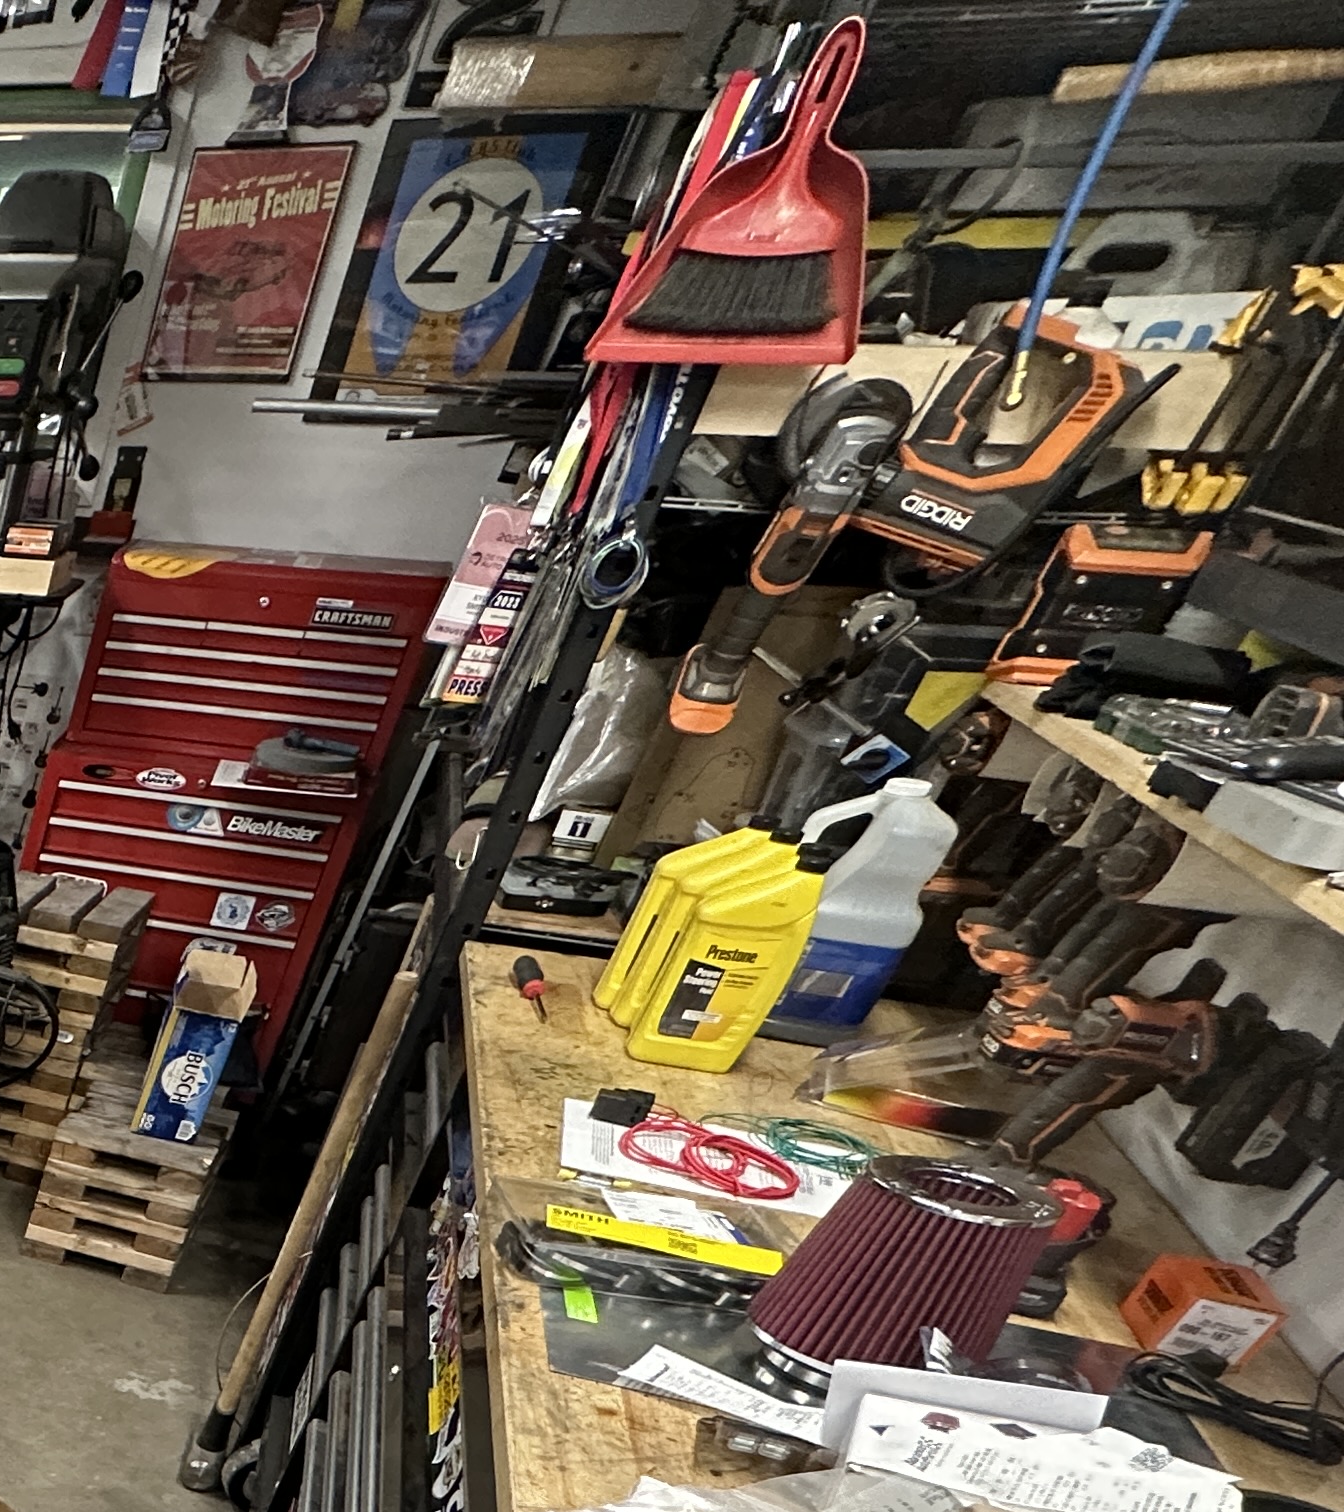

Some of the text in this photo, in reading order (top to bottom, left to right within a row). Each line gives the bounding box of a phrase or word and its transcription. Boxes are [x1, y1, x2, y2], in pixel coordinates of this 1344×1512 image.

[195, 178, 323, 231] Motoring Festival
[404, 188, 531, 284] 21
[900, 494, 974, 532] RIDGID
[494, 594, 521, 609] 2023
[313, 609, 393, 628] CRAFTSMAN
[447, 678, 488, 698] PRESS
[226, 815, 324, 842] BikeMaster
[705, 944, 759, 964] Prestone
[683, 975, 719, 988] Steering
[695, 967, 723, 980] Power
[170, 1051, 206, 1106] BUSCH
[552, 1207, 611, 1226] SMITH
